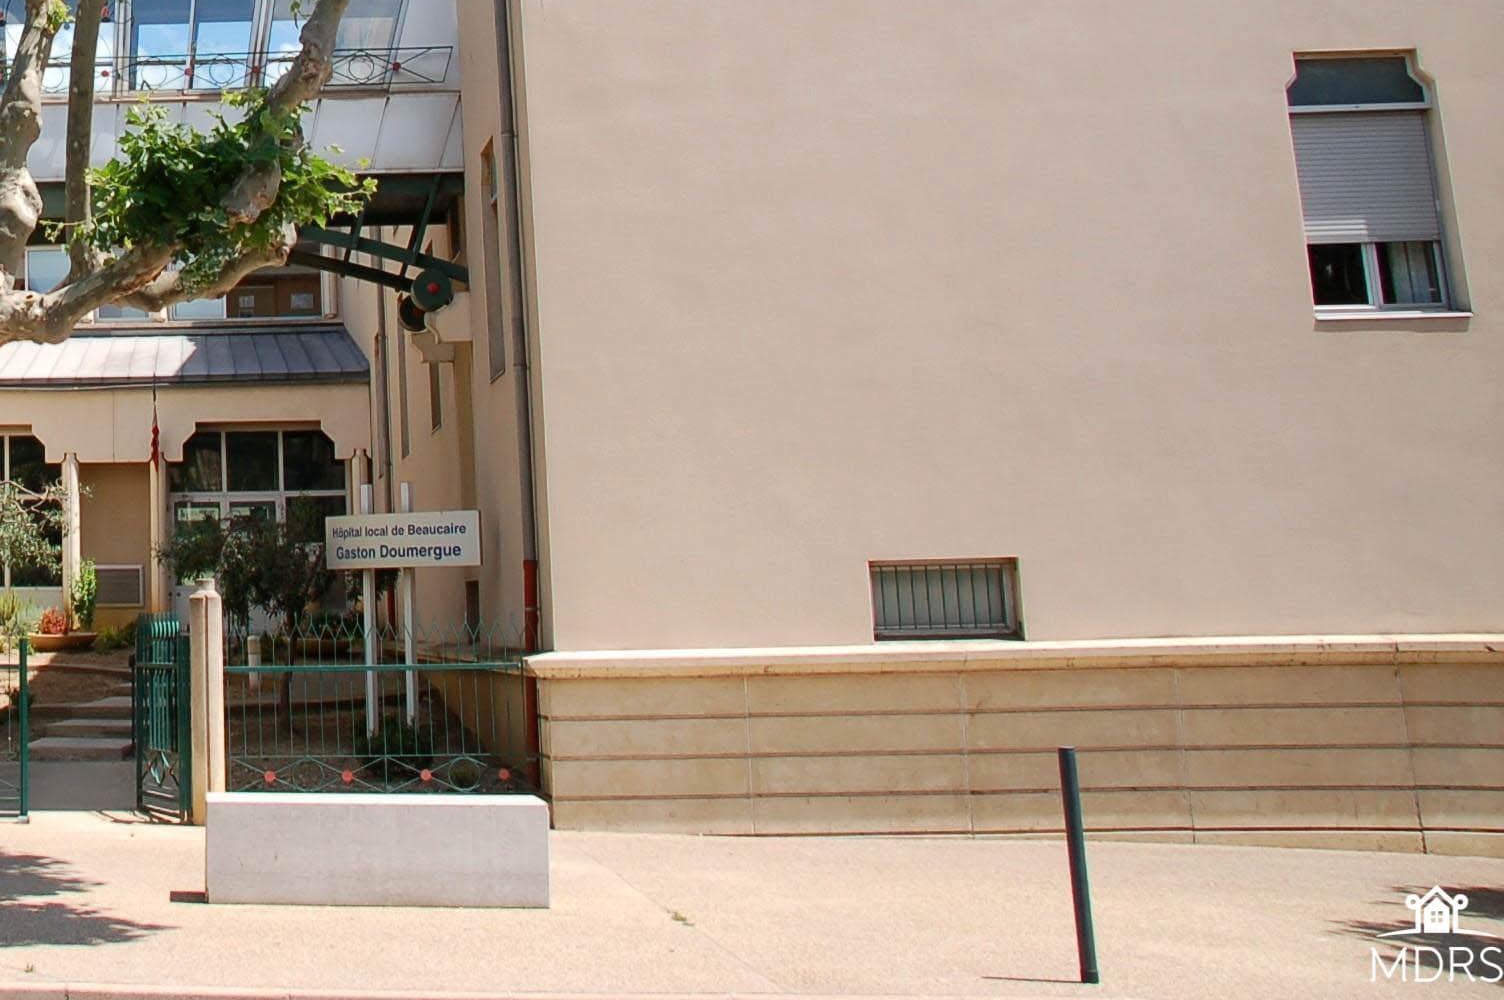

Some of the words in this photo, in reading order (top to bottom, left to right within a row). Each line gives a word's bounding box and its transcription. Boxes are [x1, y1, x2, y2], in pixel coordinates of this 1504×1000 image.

[332, 525, 362, 540] Hôpital
[364, 525, 388, 537] local
[391, 525, 404, 536] de
[407, 522, 467, 536] Beaucaire
[336, 546, 376, 560] Gaston
[380, 544, 462, 561] Doumergue
